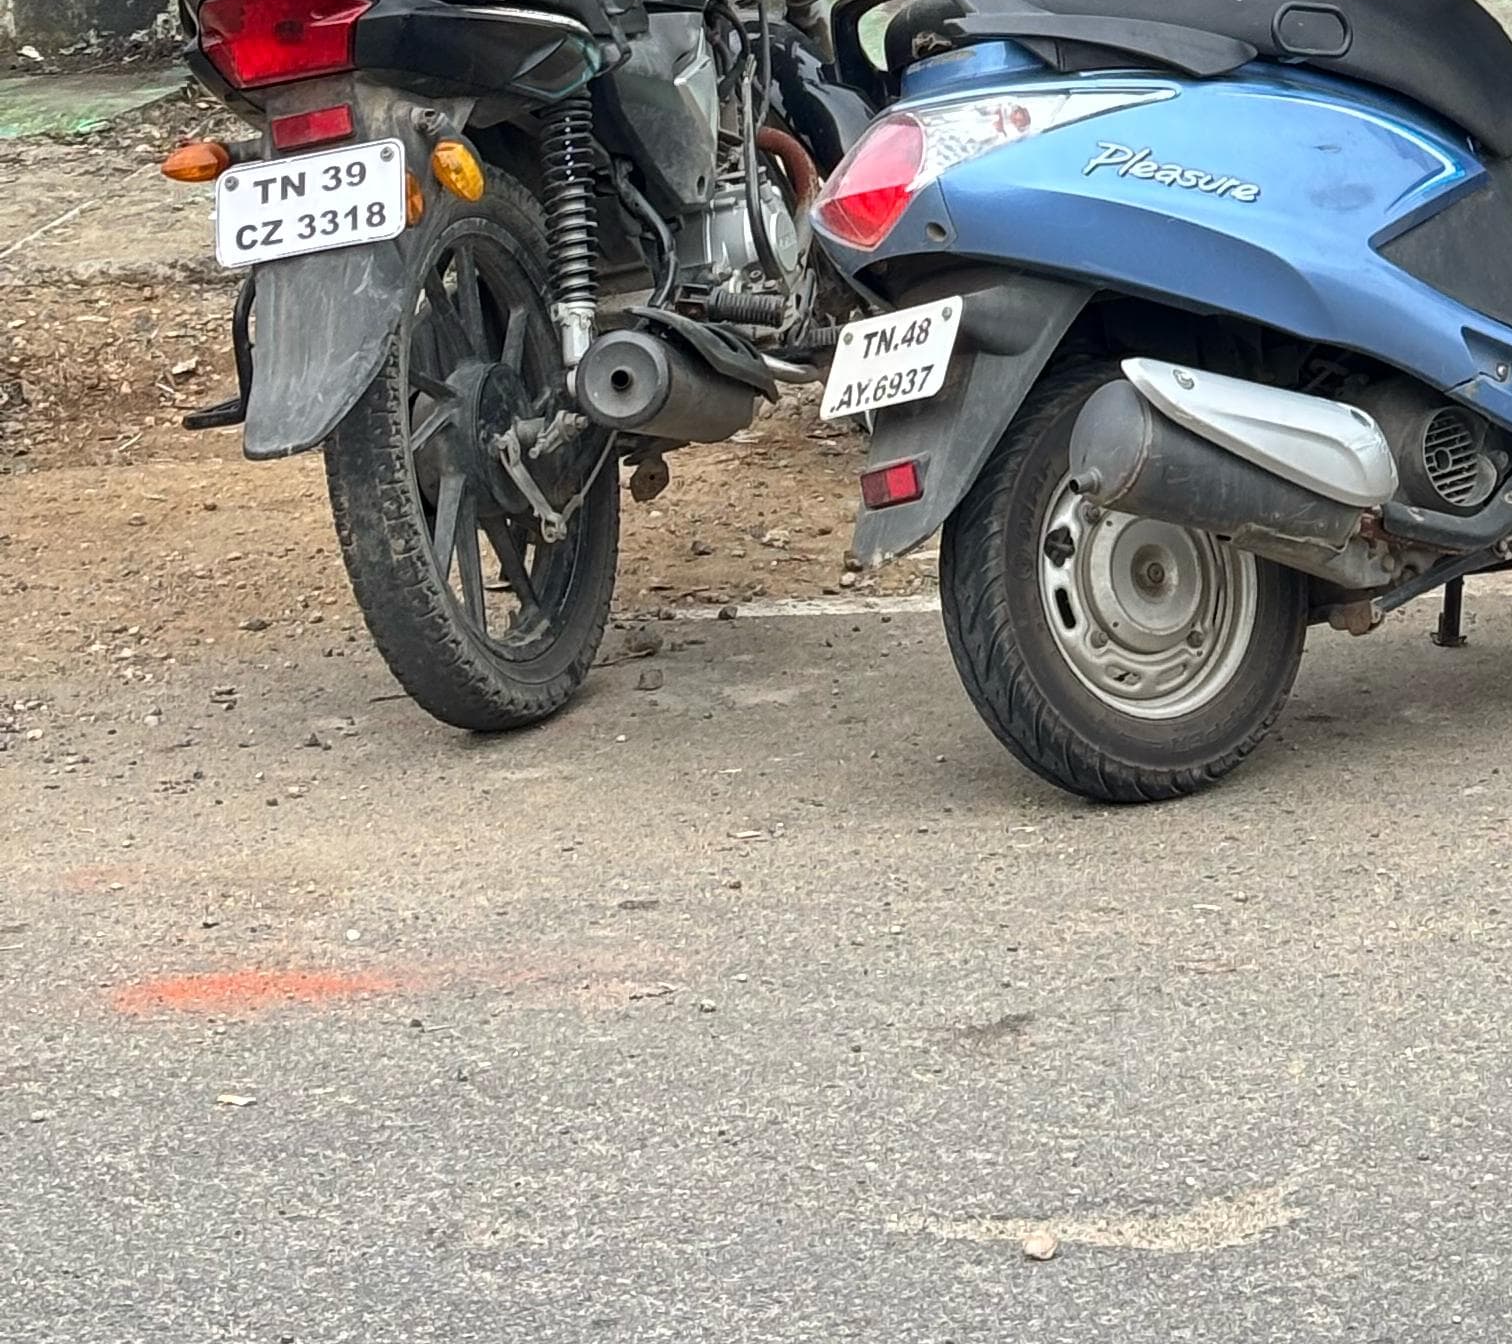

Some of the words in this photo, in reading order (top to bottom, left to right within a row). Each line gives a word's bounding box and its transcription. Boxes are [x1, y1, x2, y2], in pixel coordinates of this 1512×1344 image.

[253, 172, 306, 204] TN
[321, 161, 367, 192] 39
[1083, 142, 1261, 202] Pleasure
[235, 219, 284, 251] CZ
[297, 201, 386, 240] 3318
